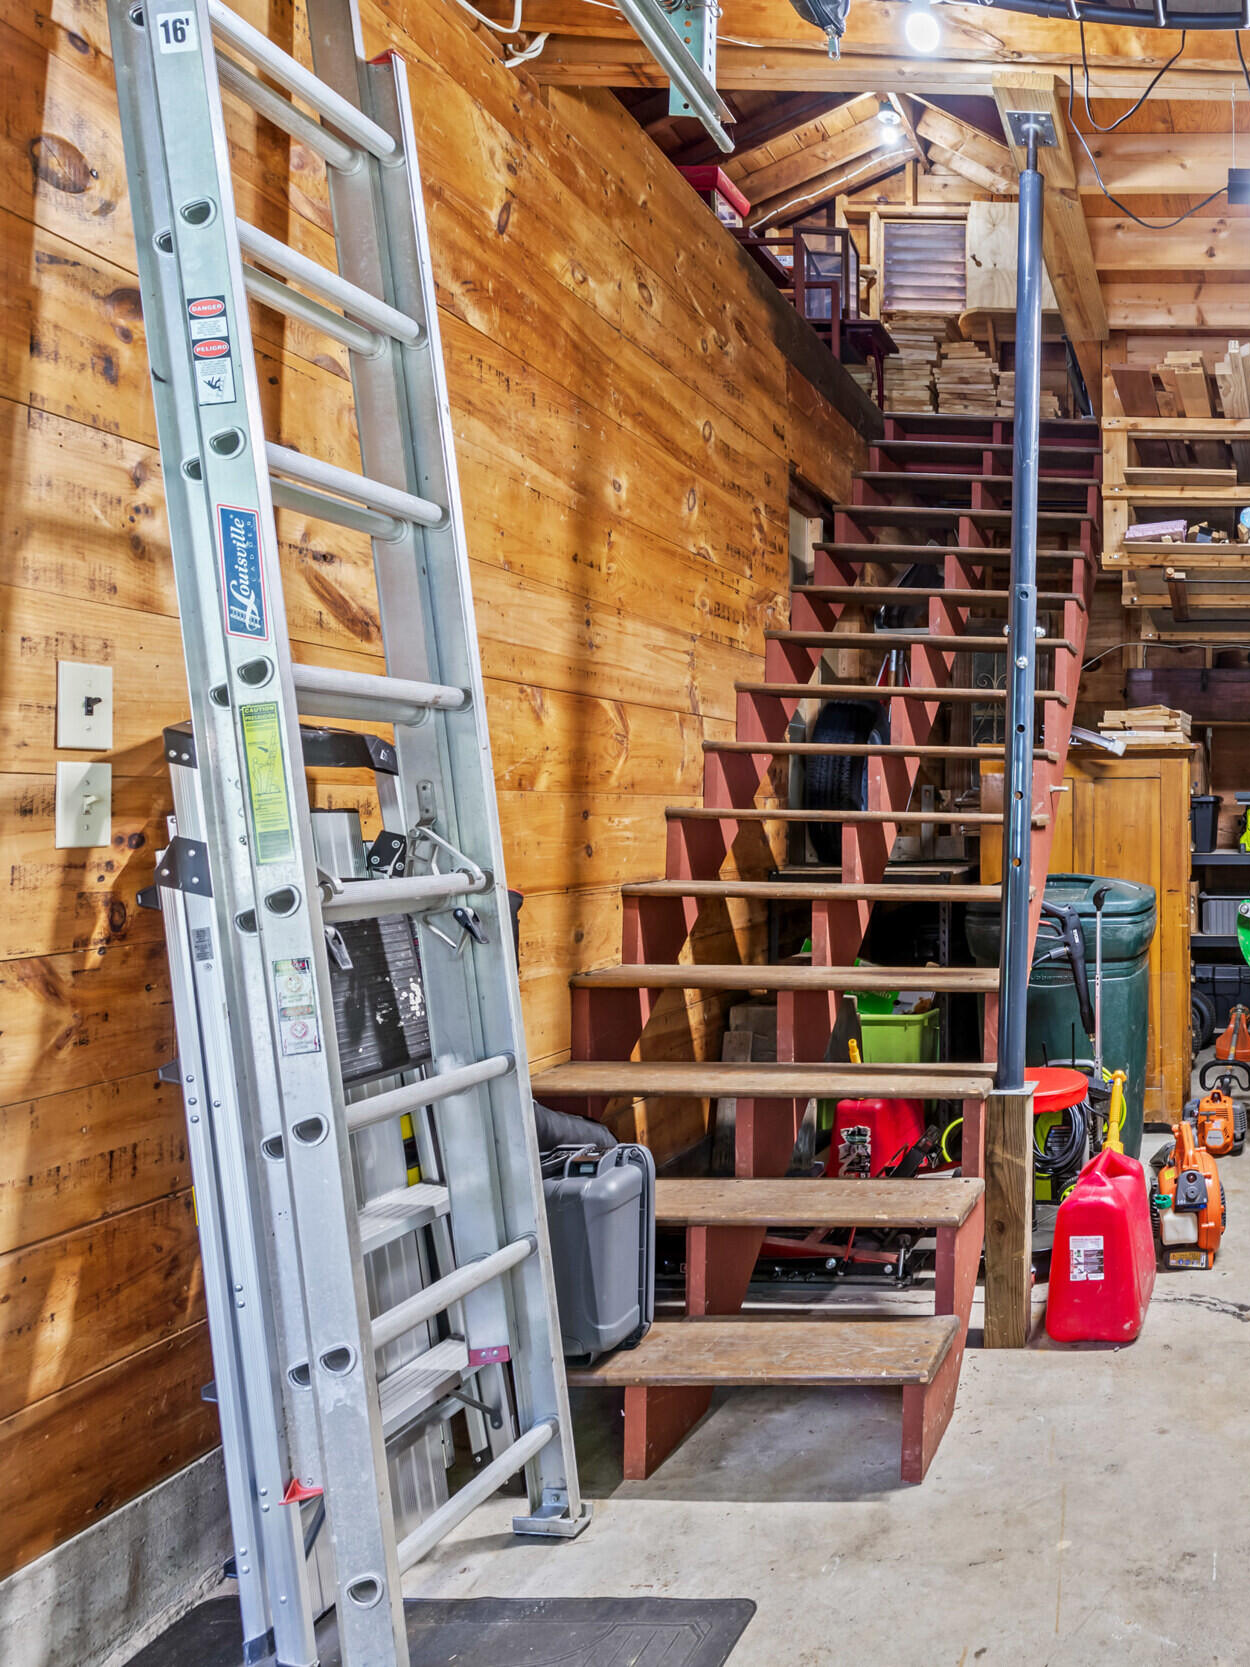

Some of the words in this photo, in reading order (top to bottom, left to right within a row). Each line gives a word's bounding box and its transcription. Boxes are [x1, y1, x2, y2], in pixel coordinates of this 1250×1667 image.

[160, 18, 190, 45] 16'
[191, 302, 223, 312] DANGER
[195, 344, 228, 353] PELIGRO
[229, 517, 261, 632] Louisville
